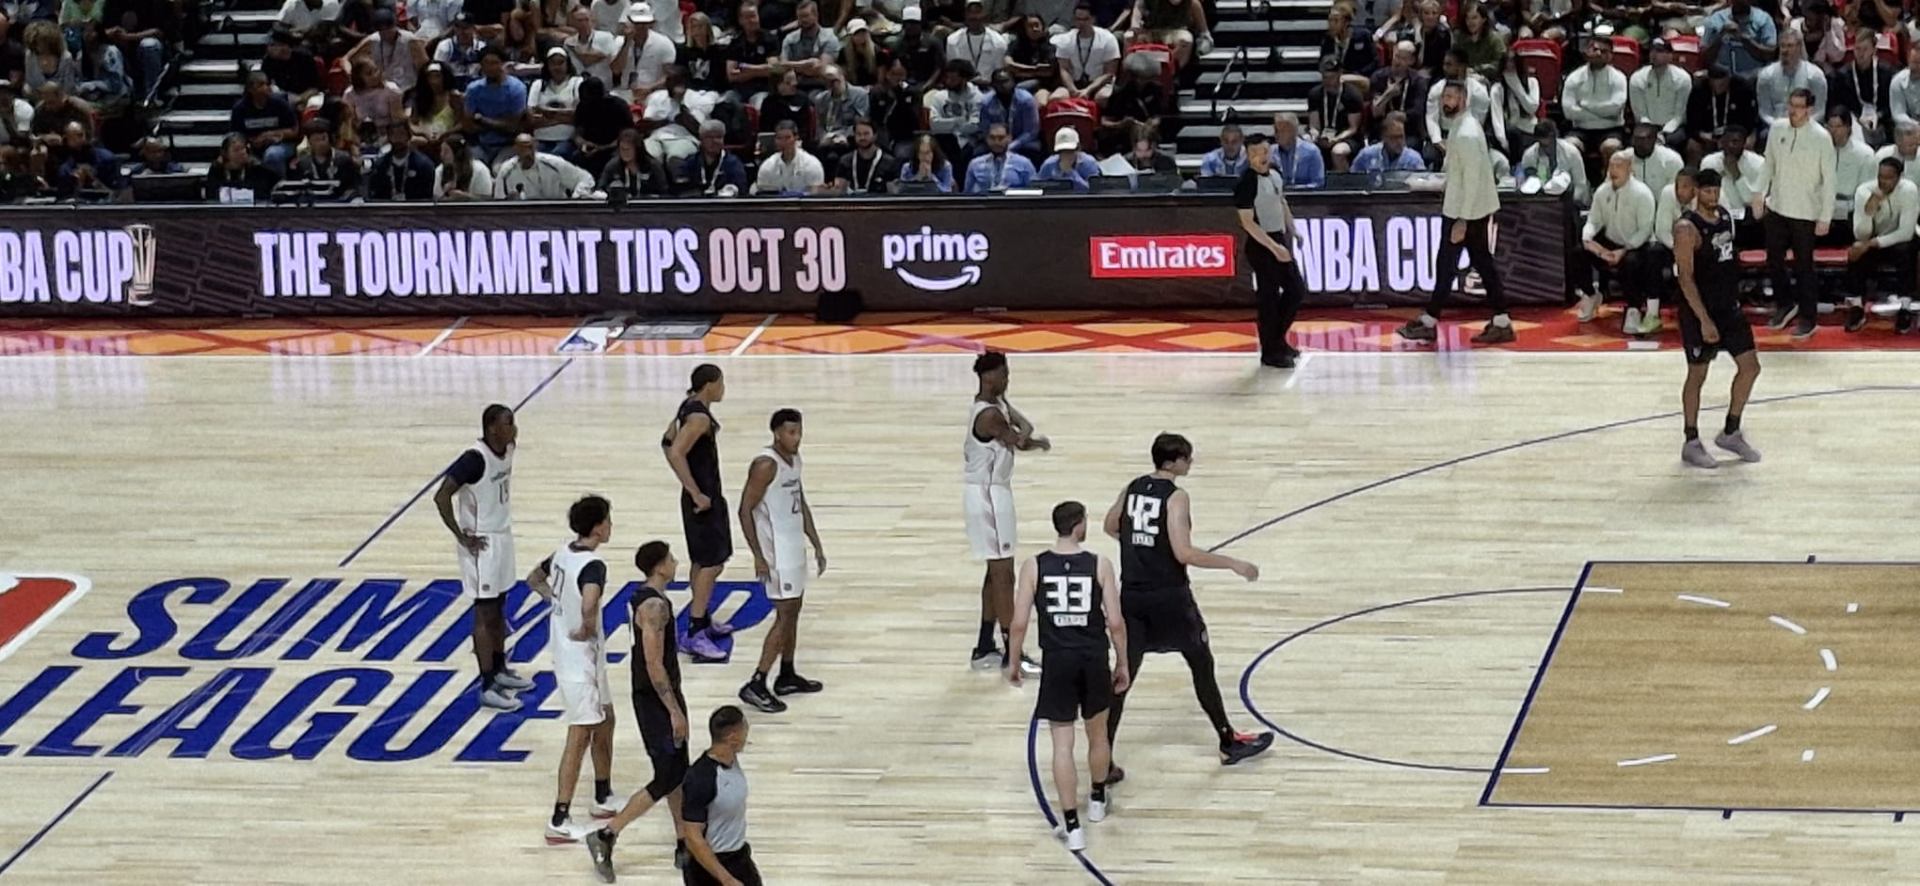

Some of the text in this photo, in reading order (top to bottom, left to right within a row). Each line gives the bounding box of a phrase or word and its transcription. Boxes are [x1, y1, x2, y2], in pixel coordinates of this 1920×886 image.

[54, 230, 133, 303] CUP
[254, 226, 846, 297] THE TOURNAMENT TIPS OCT 30
[882, 225, 989, 269] prime
[1099, 241, 1226, 269] Emirates
[1292, 216, 1471, 292] NBA CU
[1127, 493, 1162, 535] 42
[1043, 576, 1092, 613] 33
[0, 666, 565, 762] LEAGUE
